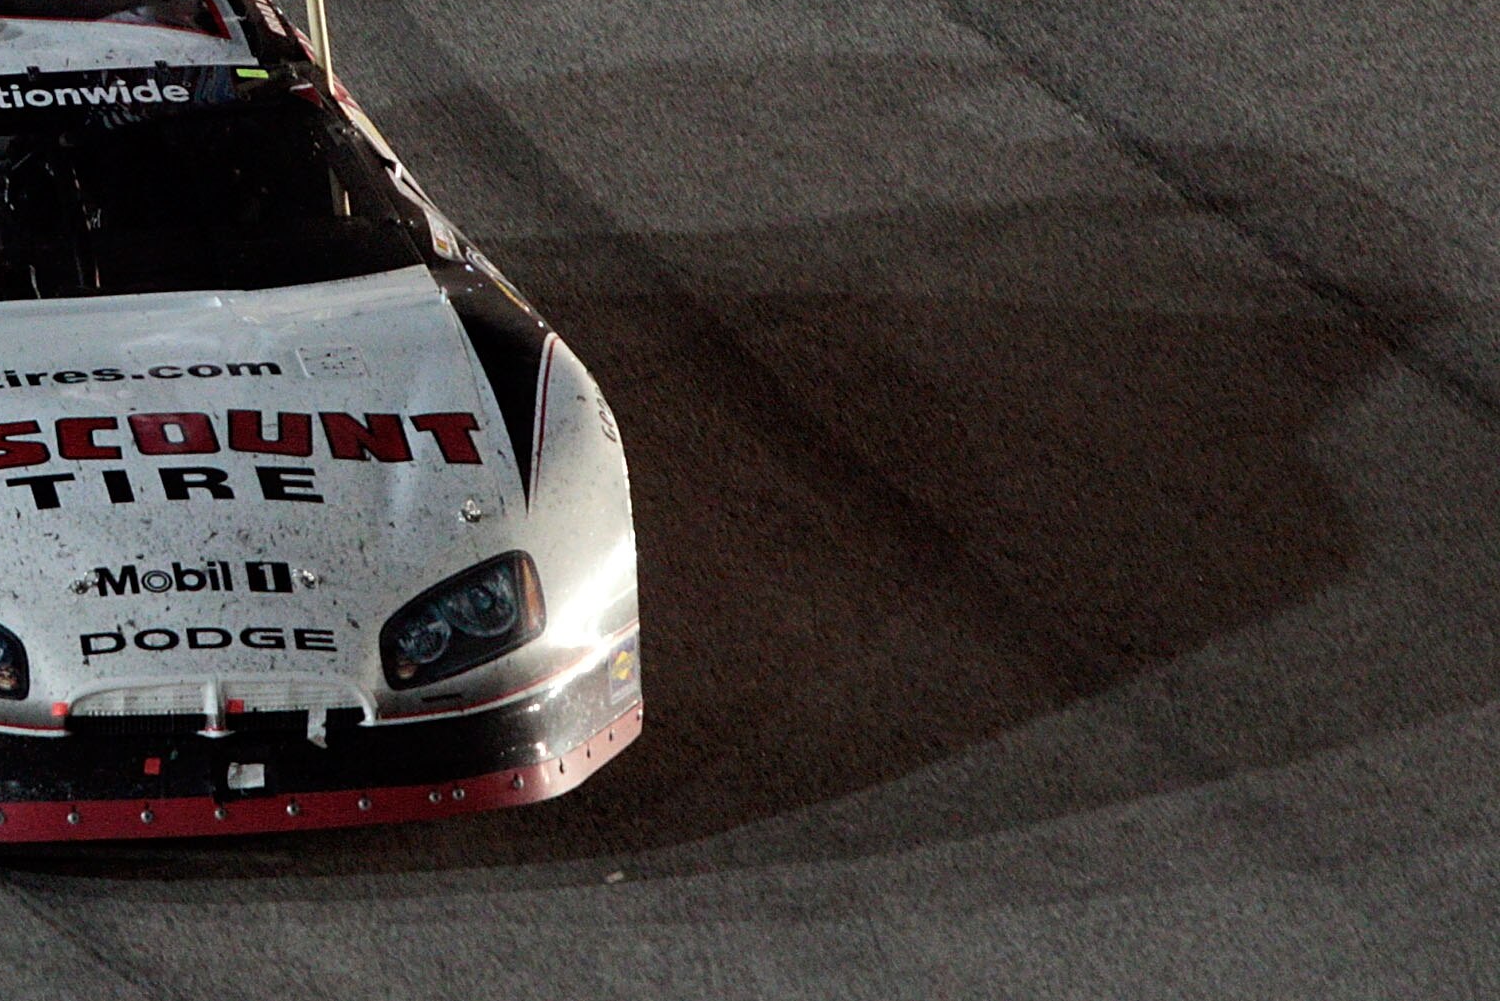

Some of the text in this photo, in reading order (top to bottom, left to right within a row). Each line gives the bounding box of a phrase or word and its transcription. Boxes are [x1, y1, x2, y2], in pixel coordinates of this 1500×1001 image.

[6, 465, 325, 510] TIRE
[97, 560, 294, 596] Mobil 1
[79, 628, 338, 656] DODGE
